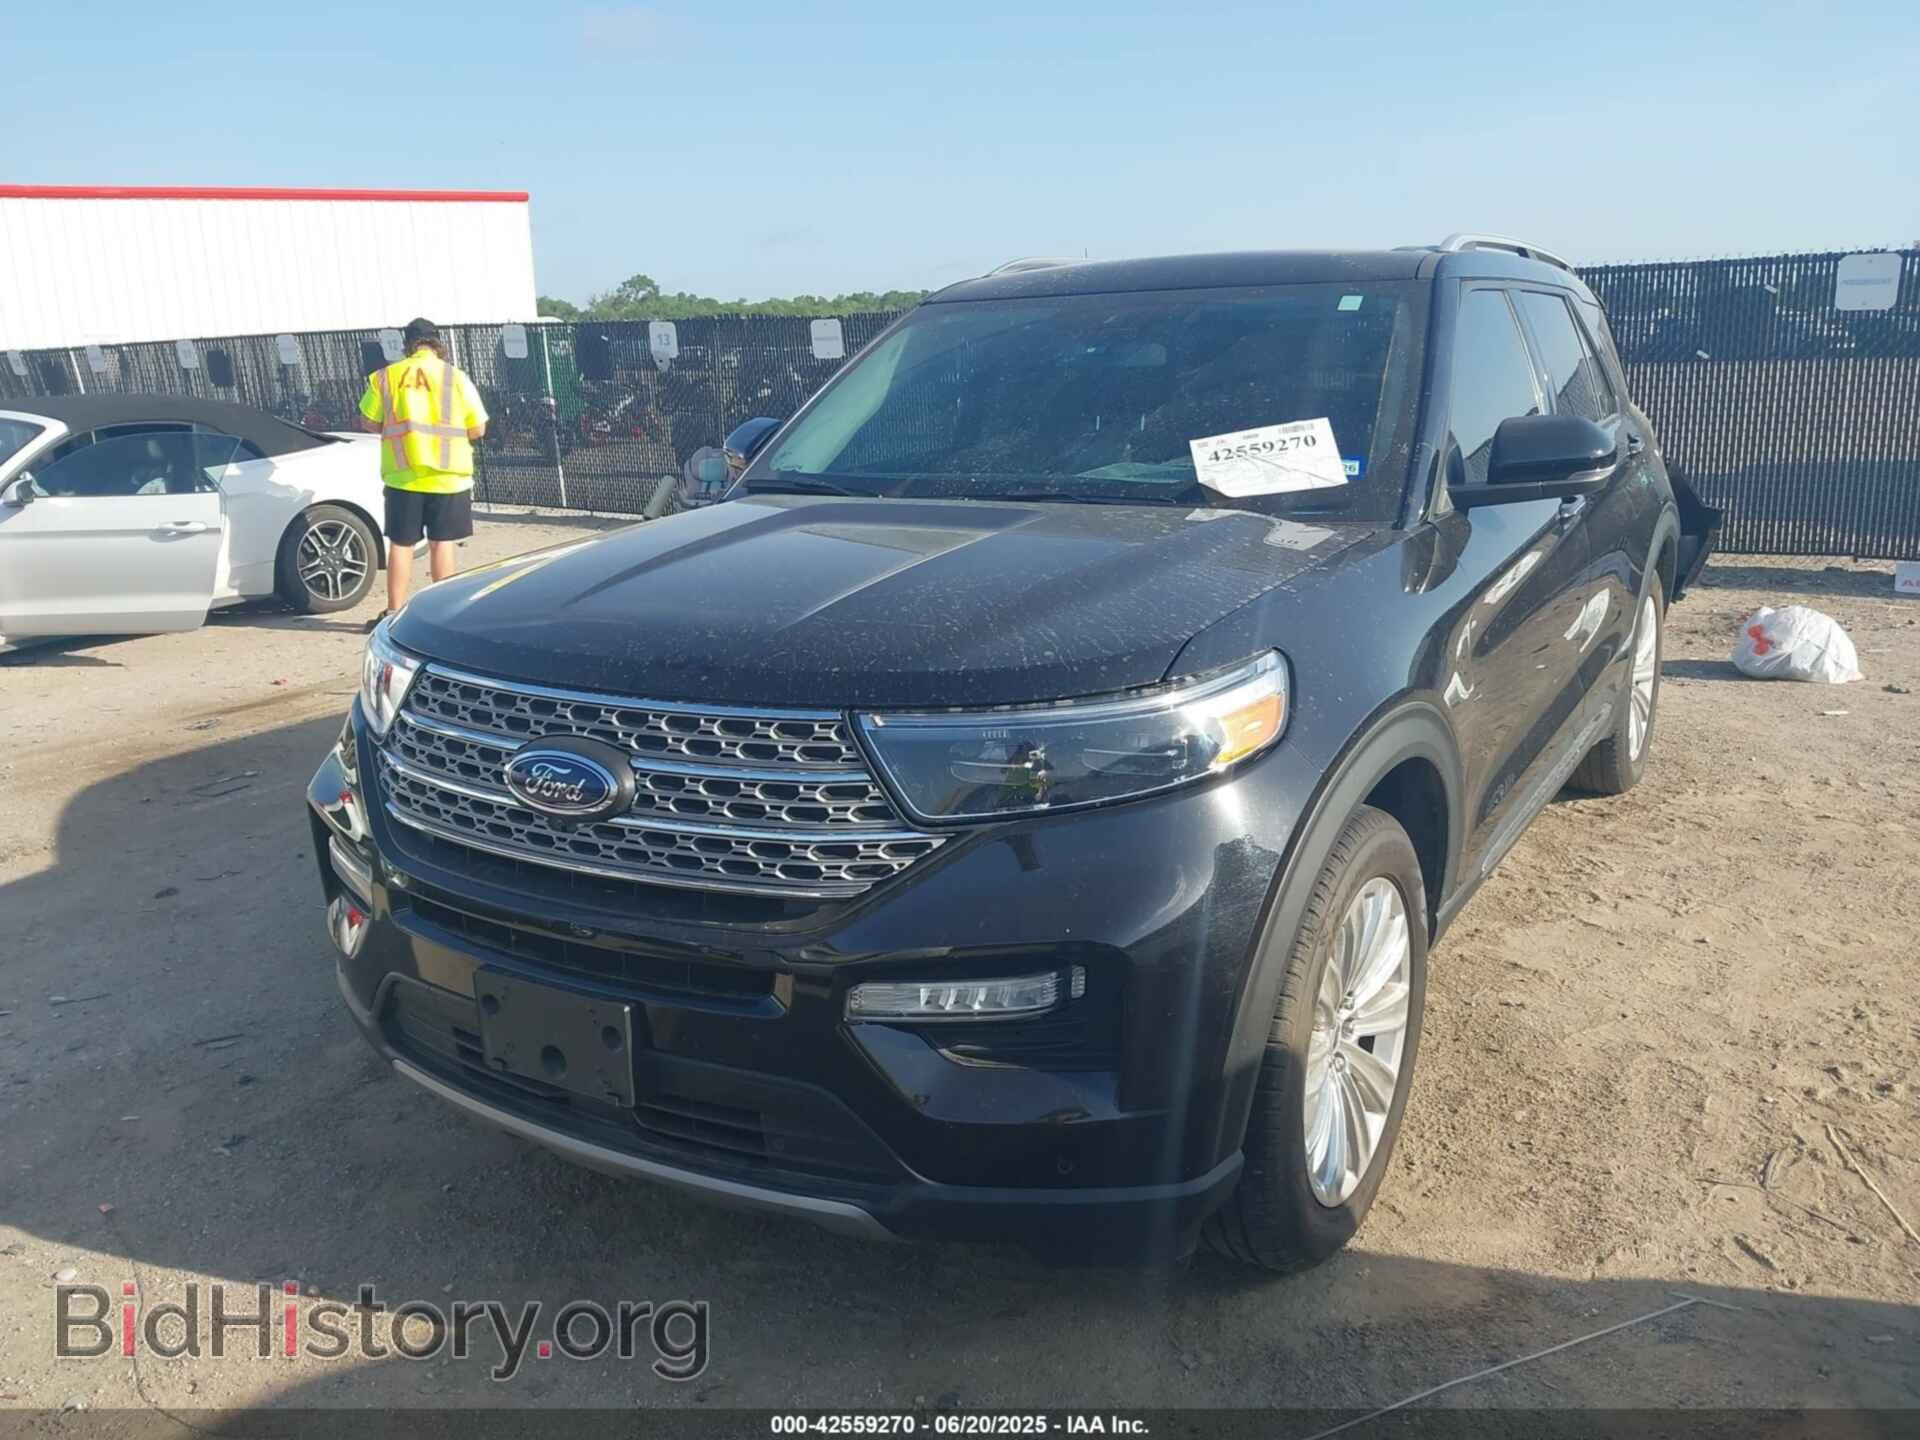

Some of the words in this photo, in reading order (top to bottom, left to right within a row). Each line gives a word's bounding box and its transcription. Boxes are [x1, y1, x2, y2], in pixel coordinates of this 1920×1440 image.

[657, 334, 671, 346] 13
[1208, 434, 1317, 463] 42559270
[525, 762, 586, 801] Ford
